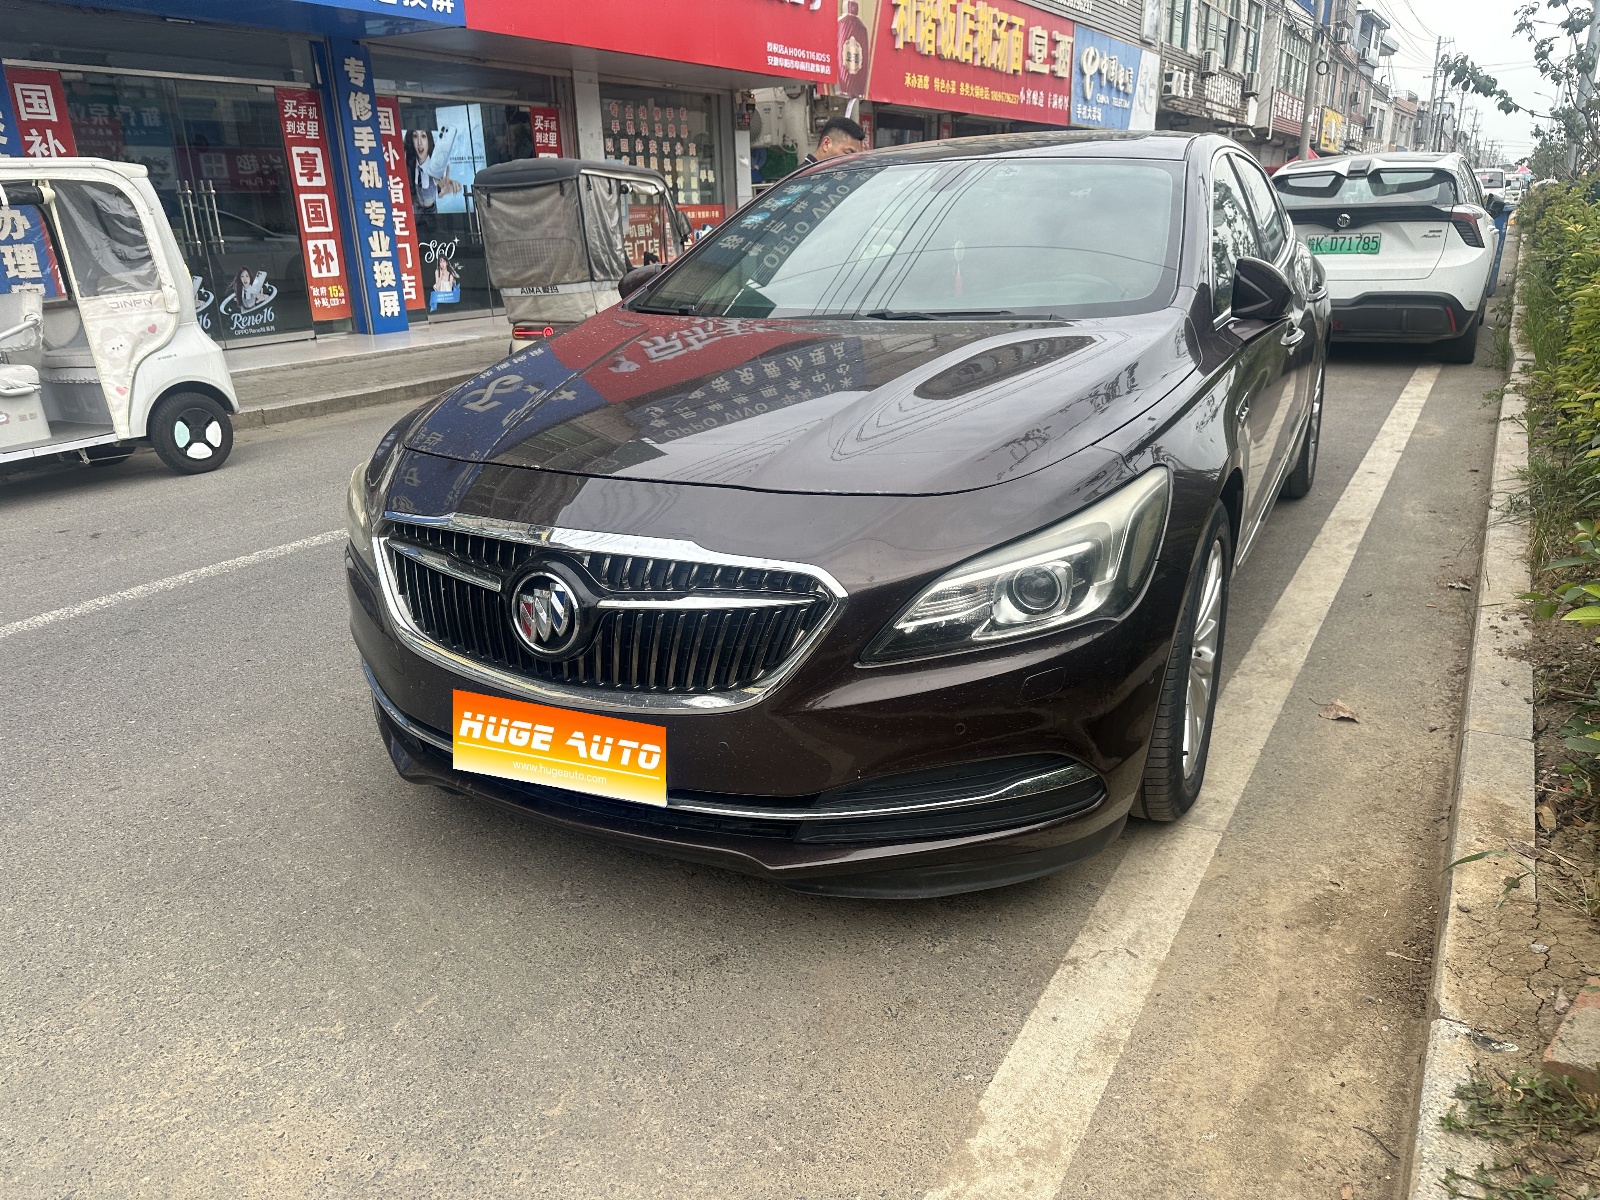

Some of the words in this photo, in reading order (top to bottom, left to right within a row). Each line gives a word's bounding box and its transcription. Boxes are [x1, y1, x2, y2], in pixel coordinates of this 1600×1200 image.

[283, 99, 318, 119] 买手机
[286, 121, 320, 139] 到这里
[534, 114, 557, 131] 买手机
[535, 131, 558, 147] 到这里
[344, 57, 382, 189] 专修手机
[364, 200, 401, 318] 专业换屏
[293, 147, 339, 277] 享国补
[1329, 236, 1379, 251] D71785
[521, 286, 543, 295] AIMA
[230, 307, 275, 331] Reno16
